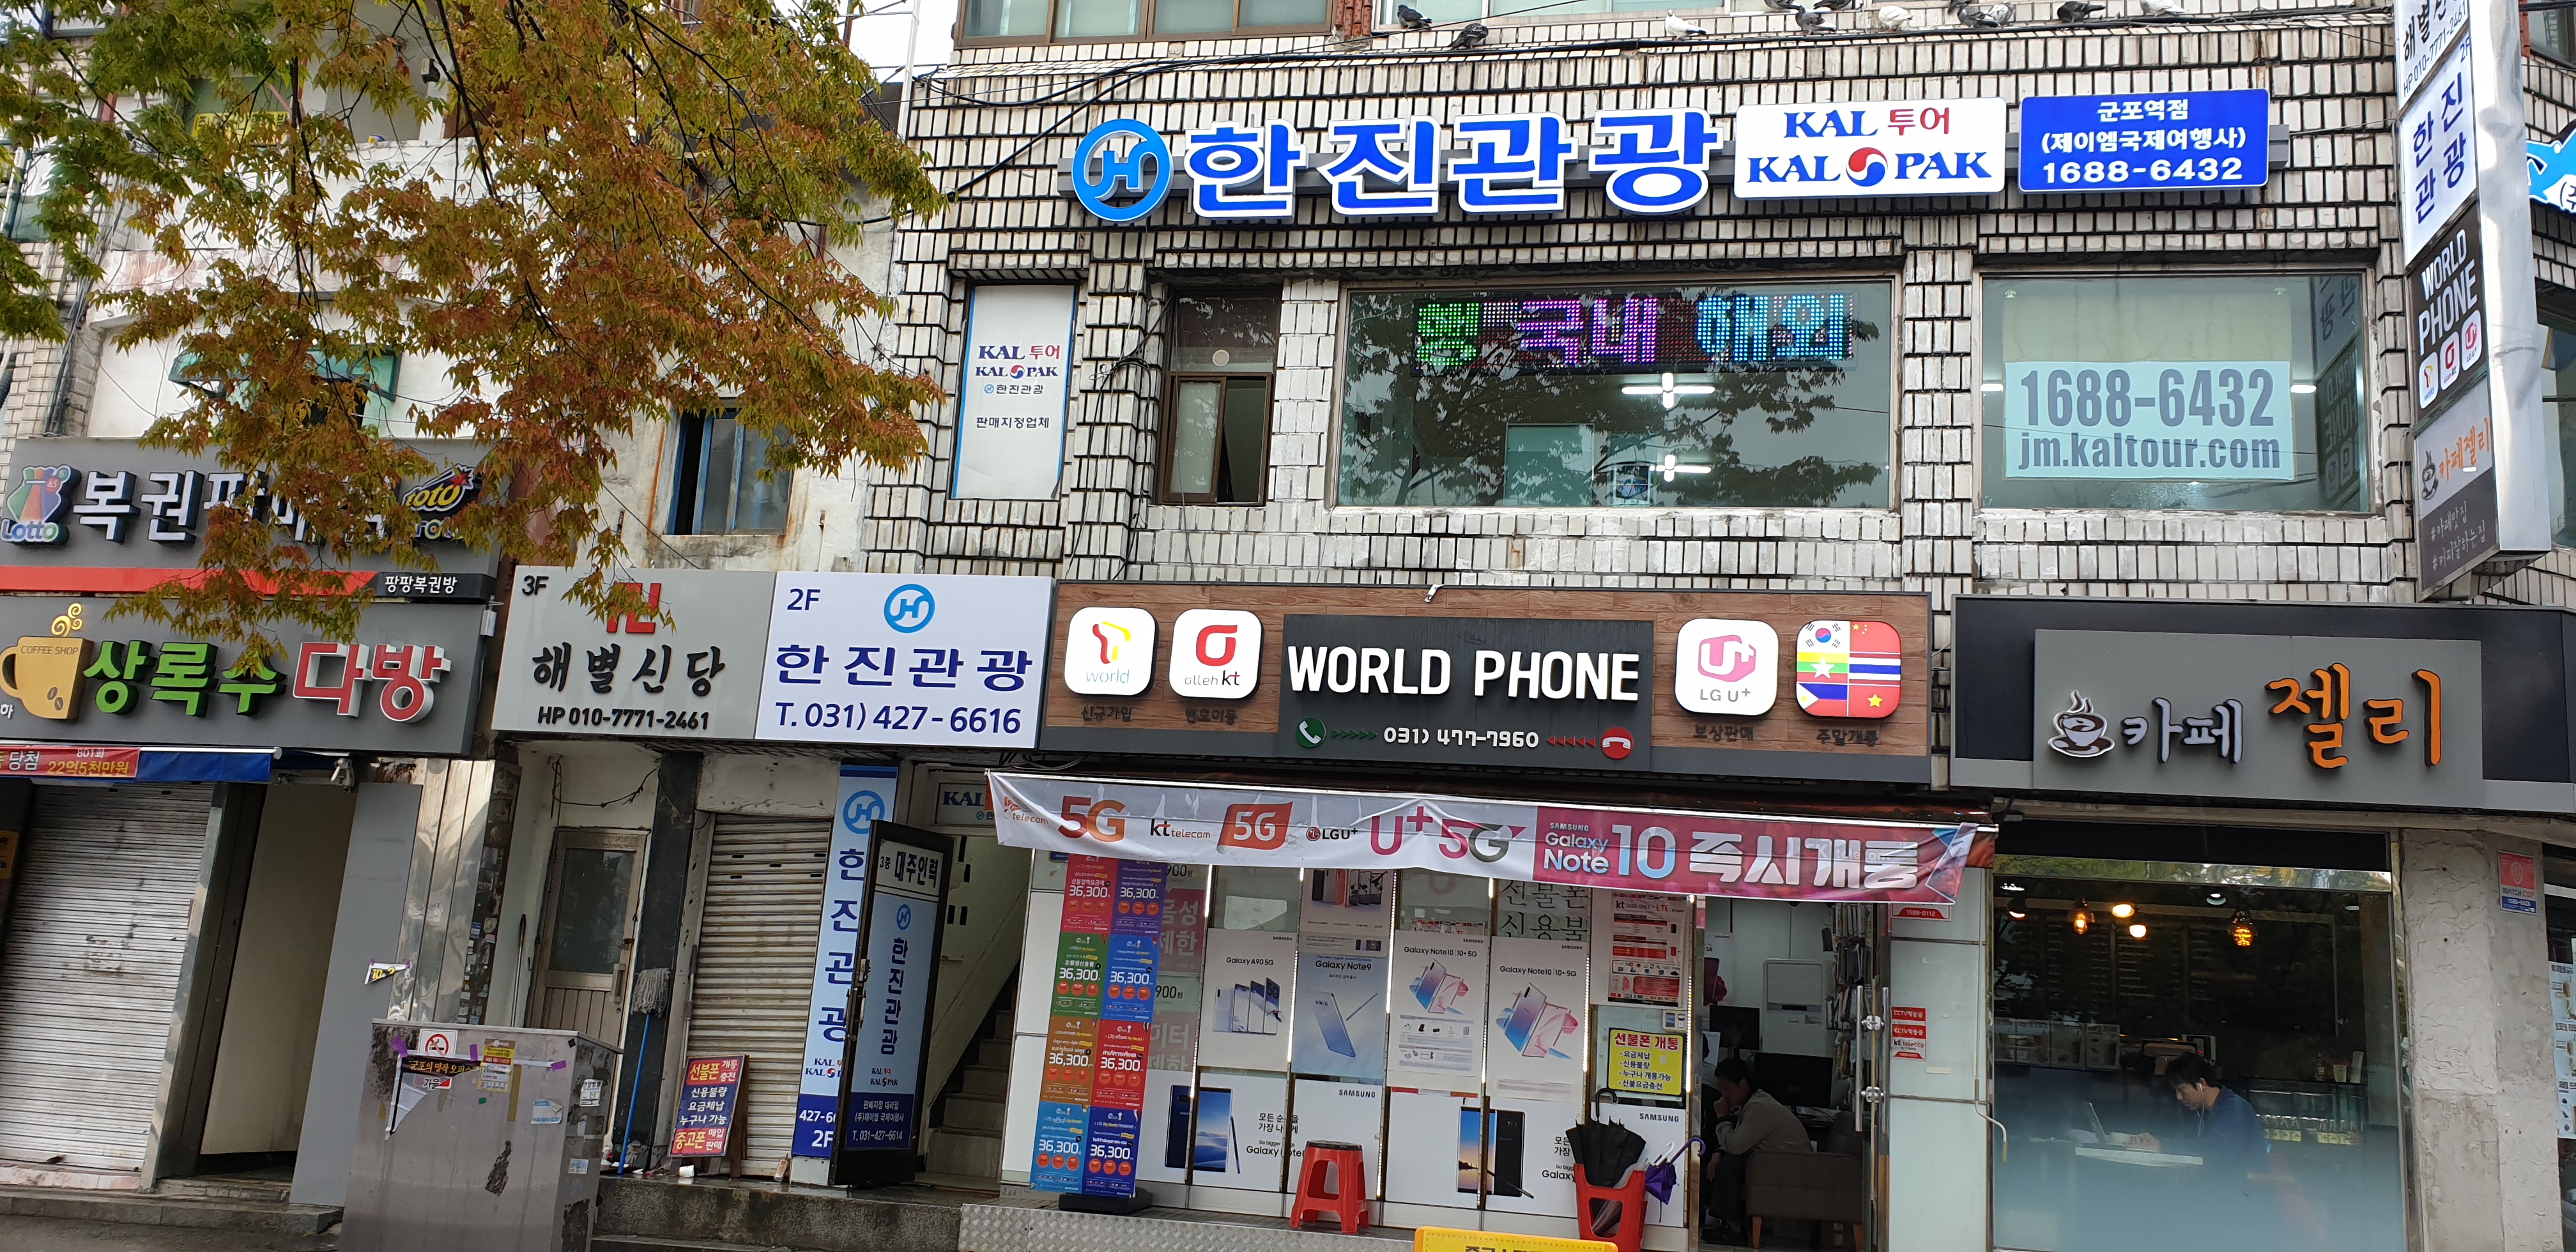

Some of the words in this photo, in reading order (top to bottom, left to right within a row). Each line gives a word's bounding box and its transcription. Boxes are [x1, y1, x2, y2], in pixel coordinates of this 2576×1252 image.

[2404, 73, 2413, 97] HP
[2414, 4, 2466, 82] 010-7771-2461
[2097, 98, 2189, 122] 군포역점
[1784, 109, 1878, 139] KAL
[1887, 105, 1951, 137] 투어
[2041, 126, 2246, 156] (제이엠국제여행사)
[1184, 107, 1722, 221] 한진관광
[1747, 155, 1843, 184] KAL
[1894, 150, 1992, 181] PAK
[2042, 156, 2244, 184] 1688-6432
[2421, 229, 2467, 301] WORLD
[2418, 258, 2478, 357] PHONE
[1517, 298, 1659, 366] 국내
[1697, 294, 1844, 362] 해외
[977, 344, 1025, 360] KAL
[1029, 344, 1061, 360] 투어
[975, 365, 1008, 377] KAL
[1026, 365, 1059, 377] PAK
[996, 384, 1044, 395] 한진관광
[2020, 369, 2274, 427] 1688-6432
[976, 416, 1050, 429] 판매지정업체
[2018, 432, 2280, 471] jm.kaltour.com
[1, 518, 59, 543] Lotto
[385, 575, 457, 594] 팡팡복권방
[521, 575, 549, 596] 3F
[786, 588, 822, 611] 2F
[20, 645, 53, 655] COFFEE
[54, 646, 79, 656] SHOP
[532, 641, 726, 698] 해별신당
[776, 643, 1034, 693] 한진관광
[1086, 668, 1130, 684] world
[1287, 645, 1452, 695] WORLD
[1474, 650, 1640, 701] PHONE
[84, 640, 281, 717] 상록수
[293, 641, 452, 723] 다방
[1184, 675, 1218, 686] olleh
[1222, 669, 1241, 686] kt
[1699, 688, 1721, 701] LG
[1728, 687, 1751, 702] U+
[537, 705, 565, 726] HP
[567, 707, 710, 730] 010-7771-2461
[775, 701, 799, 728] T.
[804, 703, 868, 731] 031)
[872, 705, 1022, 735] 427-6616
[1081, 705, 1133, 722] 신규가입
[1185, 706, 1238, 725] 번호이동
[2121, 696, 2244, 765] 카페
[2264, 662, 2442, 770] 젤리
[1383, 726, 1430, 745] 031)
[1437, 728, 1539, 749] 477-7960
[1693, 723, 1754, 742] 보상판매
[1816, 728, 1879, 747] 주말개통
[8, 751, 40, 771] 당첨
[76, 747, 106, 760] 801회
[47, 760, 129, 777] 22억5천만원
[942, 791, 985, 807] KAL
[1011, 812, 1049, 826] telecom
[1057, 795, 1126, 843] 5G
[1233, 810, 1276, 842] 5G
[1549, 822, 1589, 832] SAMSUNG
[1150, 818, 1170, 837] kt
[1170, 828, 1211, 839] telecom
[1545, 832, 1609, 853] Galaxy
[1611, 823, 1676, 879] 10
[1543, 849, 1609, 874] Note
[1689, 831, 1918, 889] 즉시개통
[879, 856, 891, 870] 3층
[894, 851, 939, 889] 대주인력
[1069, 885, 1108, 898] 36,300
[1119, 887, 1156, 899] 36,300
[1615, 900, 1625, 910] kt
[1404, 946, 1429, 956] Galaxy
[1225, 957, 1250, 966] Galaxy
[1251, 958, 1264, 966] A90
[1315, 960, 1346, 971] Galaxy
[1347, 962, 1372, 971] Note9
[1499, 965, 1526, 975] Galaxy
[1527, 967, 1552, 975] Note10
[1059, 967, 1098, 981] 36,300
[1110, 971, 1150, 985] 36,300
[880, 937, 908, 1055] 한진관광
[1614, 1032, 1652, 1049] 선불폰
[1654, 1034, 1680, 1051] 개통
[814, 1058, 834, 1066] KAL
[1048, 1052, 1089, 1067] 36,300
[1623, 1050, 1651, 1060] 요금체납
[434, 1062, 450, 1074] 명작
[689, 1062, 720, 1081] 선불폰
[721, 1060, 738, 1070] 개통
[805, 1067, 825, 1076] KAL
[1100, 1057, 1141, 1072] 36,300
[1623, 1060, 1651, 1070] 신용불량
[1622, 1069, 1644, 1080] 누구나
[1644, 1071, 1671, 1082] 개통가능
[691, 1086, 728, 1098] 신용불량
[1338, 1088, 1376, 1099] SAMSUNG
[687, 1101, 725, 1112] 요금체납
[863, 1100, 884, 1110] 판매지정
[884, 1101, 900, 1110] 대리점
[679, 1115, 708, 1126] 누구나
[708, 1114, 727, 1125] 가능
[1259, 1113, 1275, 1122] 모든
[1639, 1112, 1680, 1123] SAMSUNG
[852, 1130, 858, 1141] T.
[859, 1129, 903, 1141] 031-427-6614
[1258, 1122, 1274, 1133] 가장
[675, 1131, 705, 1150] 중고폰
[708, 1128, 724, 1139] 매입
[705, 1140, 723, 1151] 판매
[1038, 1139, 1079, 1155] 36,300
[1090, 1143, 1131, 1160] 36,300
[1246, 1145, 1279, 1157] Galaxy
[1554, 1146, 1571, 1157] 가장
